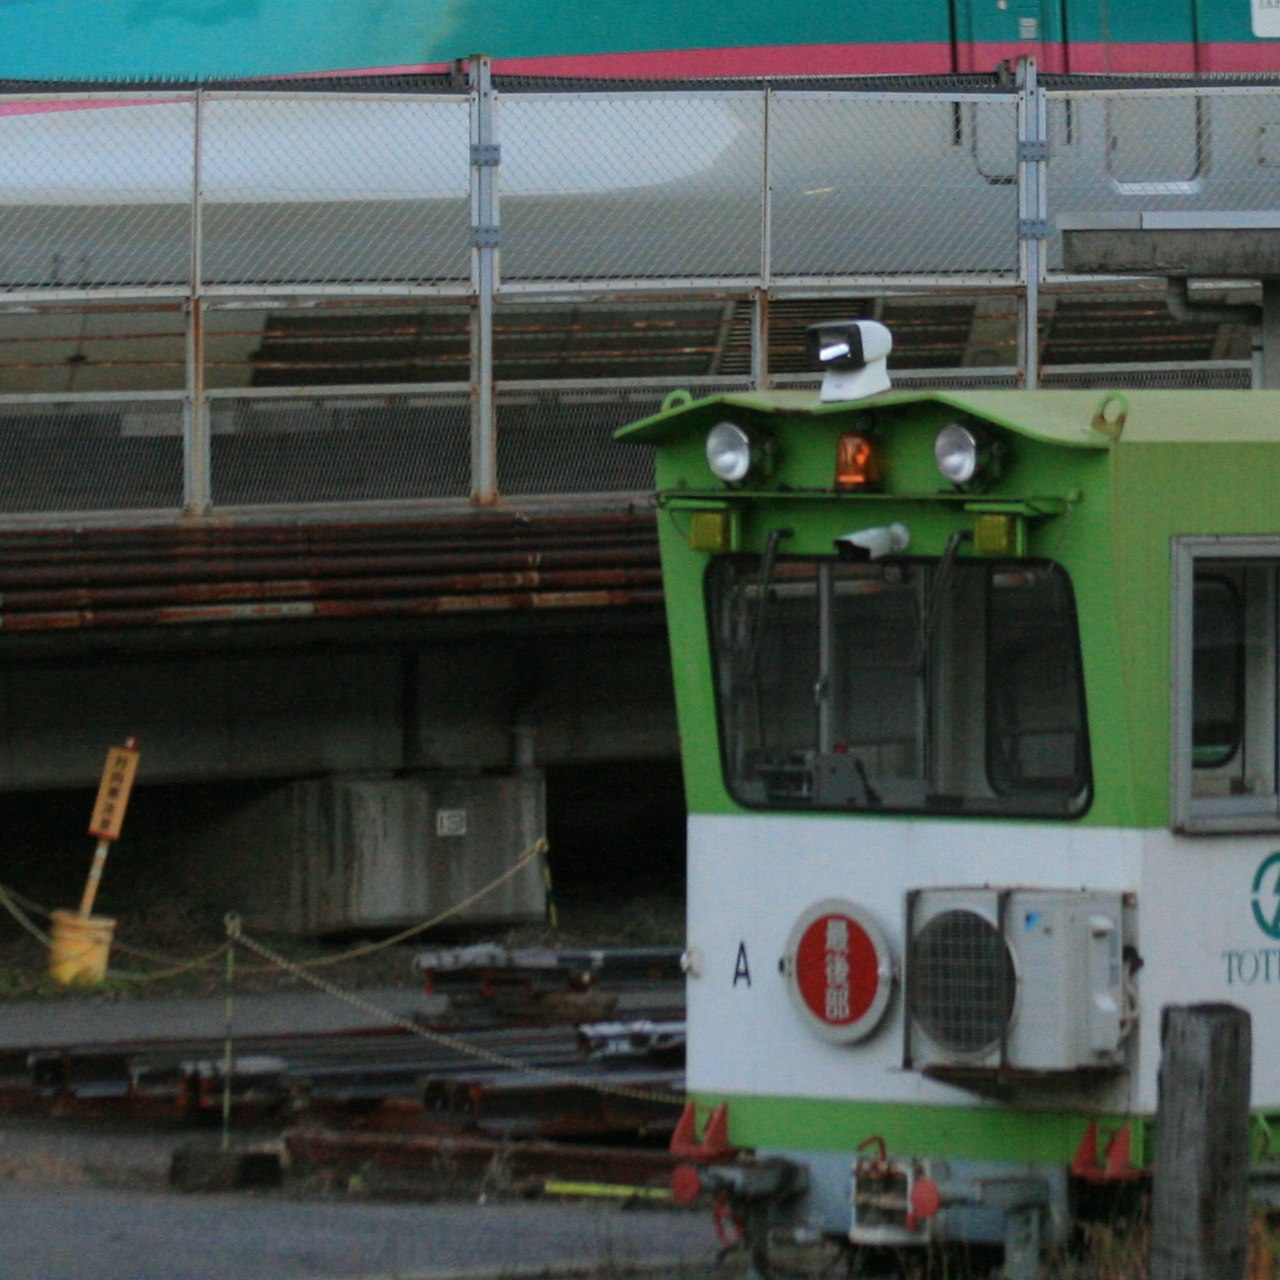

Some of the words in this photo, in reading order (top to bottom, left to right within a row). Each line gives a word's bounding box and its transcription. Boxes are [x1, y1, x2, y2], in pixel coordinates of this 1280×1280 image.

[732, 939, 752, 989] A
[824, 919, 851, 1022] 最後部
